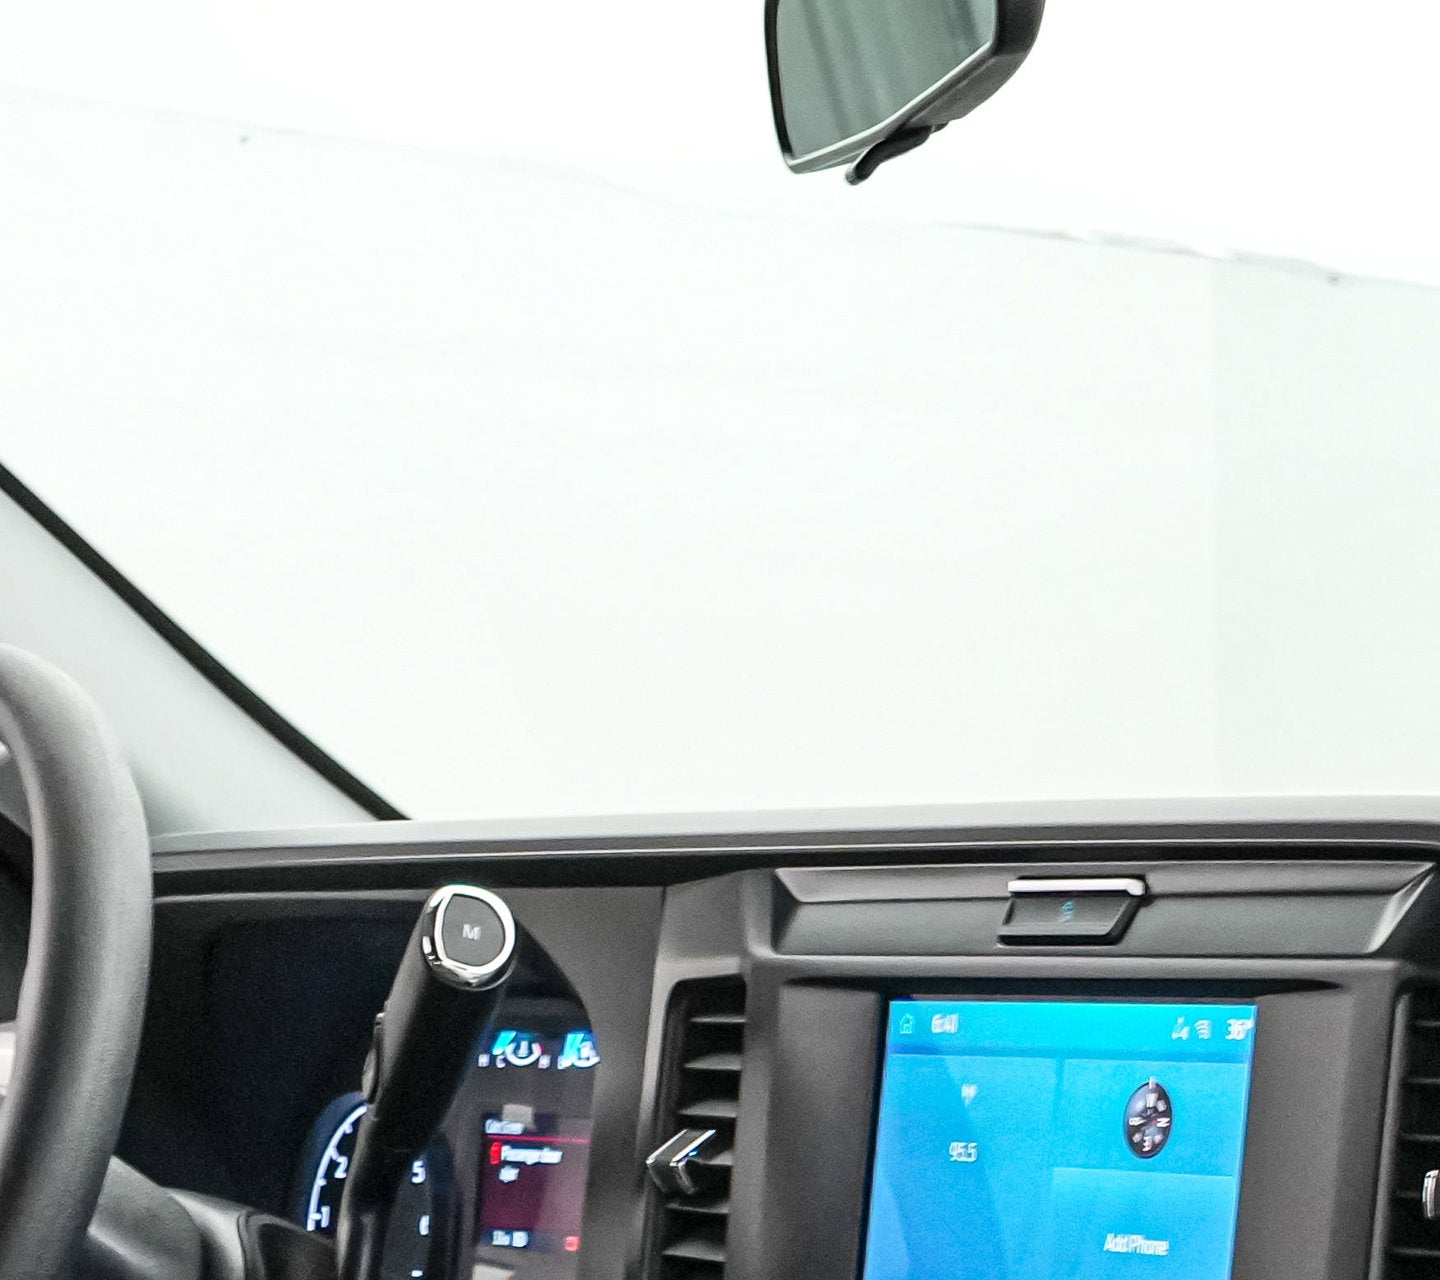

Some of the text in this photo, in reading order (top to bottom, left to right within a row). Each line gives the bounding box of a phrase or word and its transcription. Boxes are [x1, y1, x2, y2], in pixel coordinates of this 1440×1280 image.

[462, 923, 481, 941] M
[334, 1156, 349, 1179] 2
[411, 1160, 426, 1184] 5
